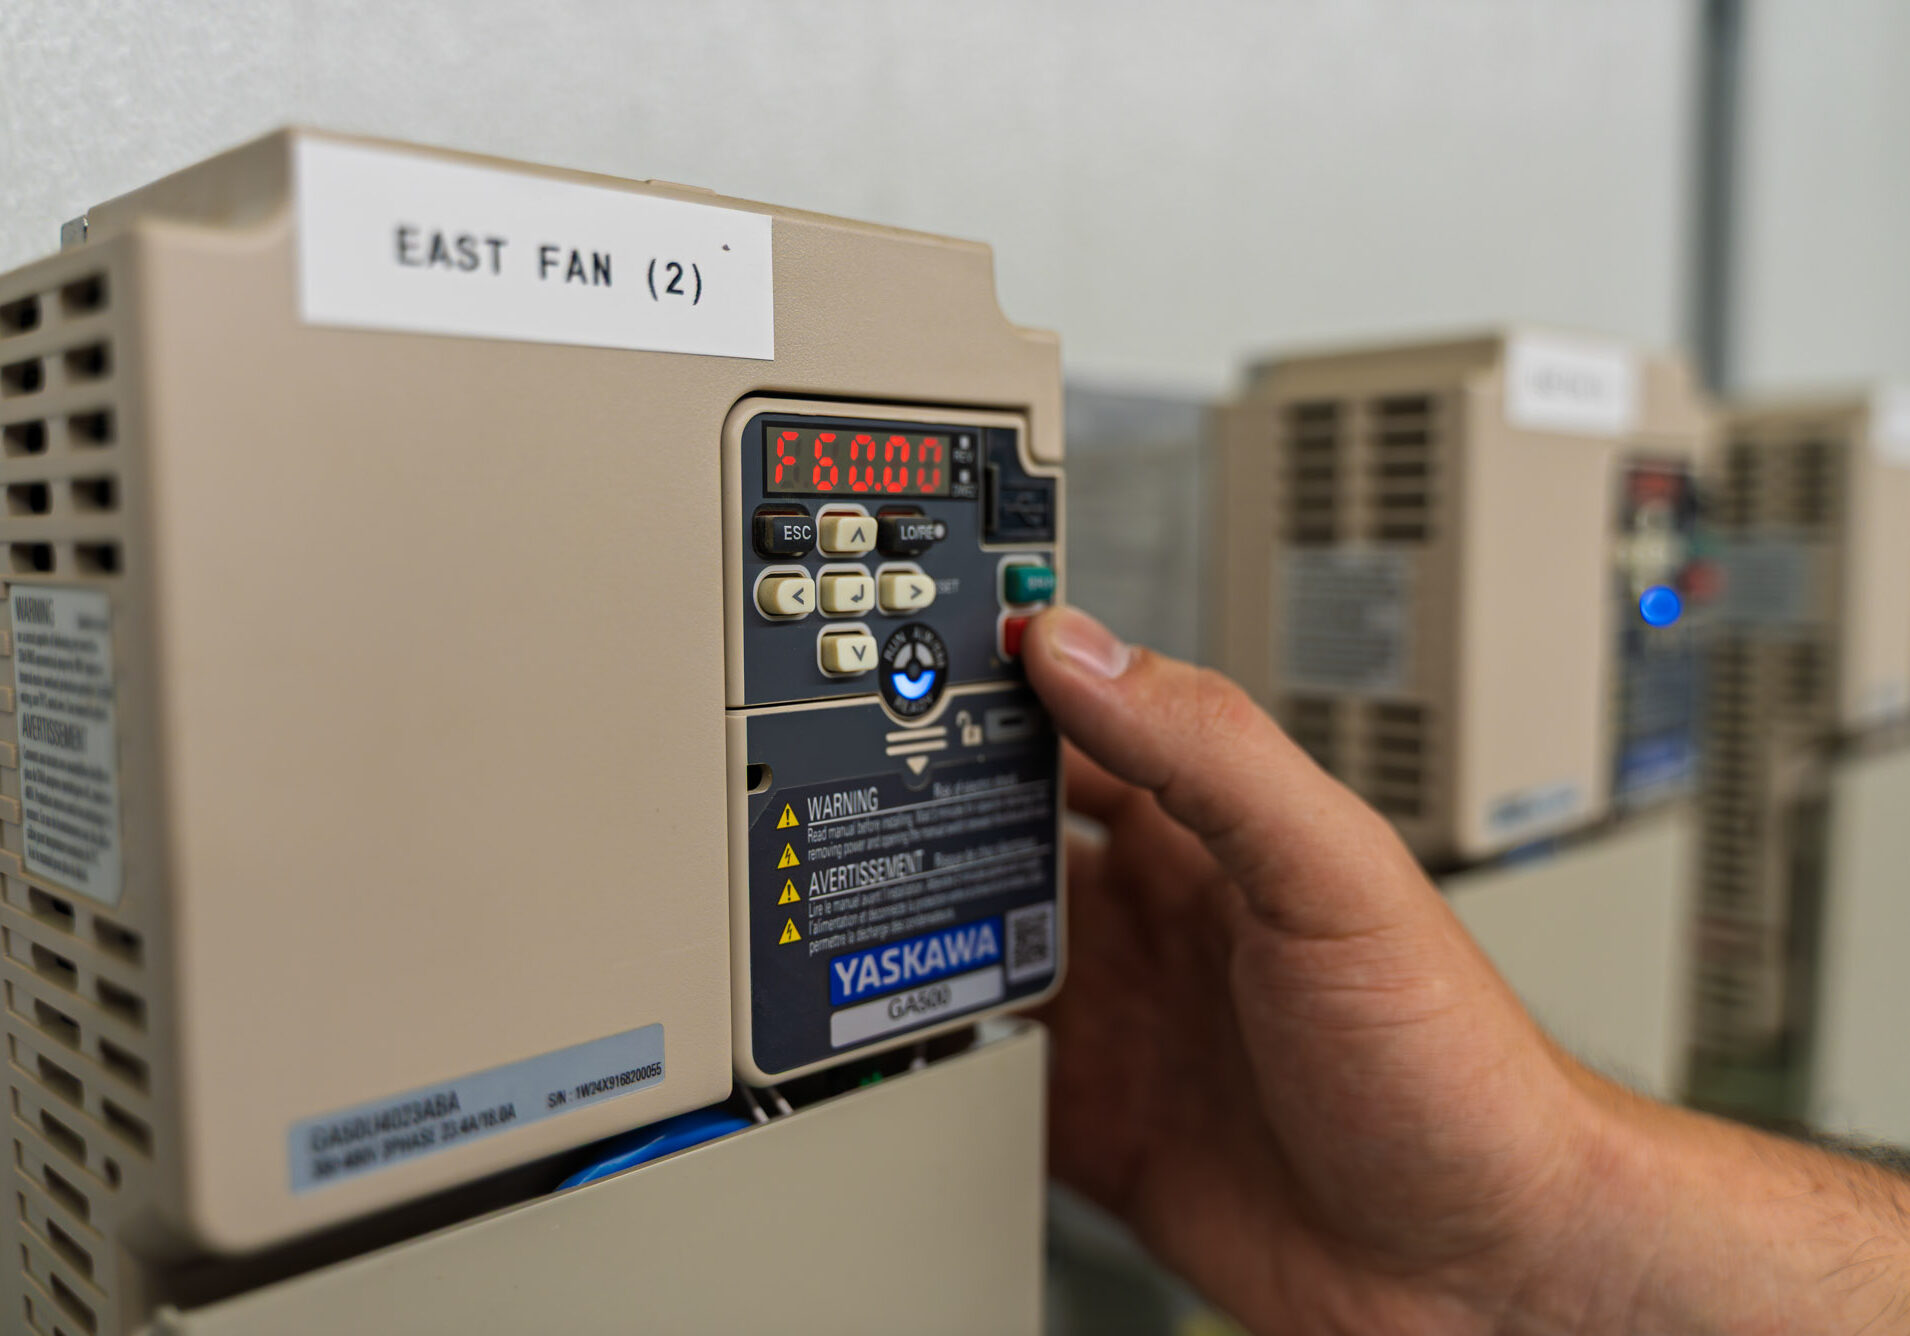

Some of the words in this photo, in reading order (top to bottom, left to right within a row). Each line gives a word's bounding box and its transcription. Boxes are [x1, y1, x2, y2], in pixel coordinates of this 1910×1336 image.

[395, 223, 507, 276] EAST
[539, 244, 613, 288] FAN
[648, 258, 703, 306] (2)
[783, 525, 812, 541] ESC
[807, 786, 879, 822] WARNING
[807, 825, 827, 843] Read
[808, 849, 926, 896] AVERTISSEMENT
[834, 923, 999, 997] YASKAWA
[887, 983, 953, 1022] GA500
[575, 1062, 663, 1099] 1W24X9168200055
